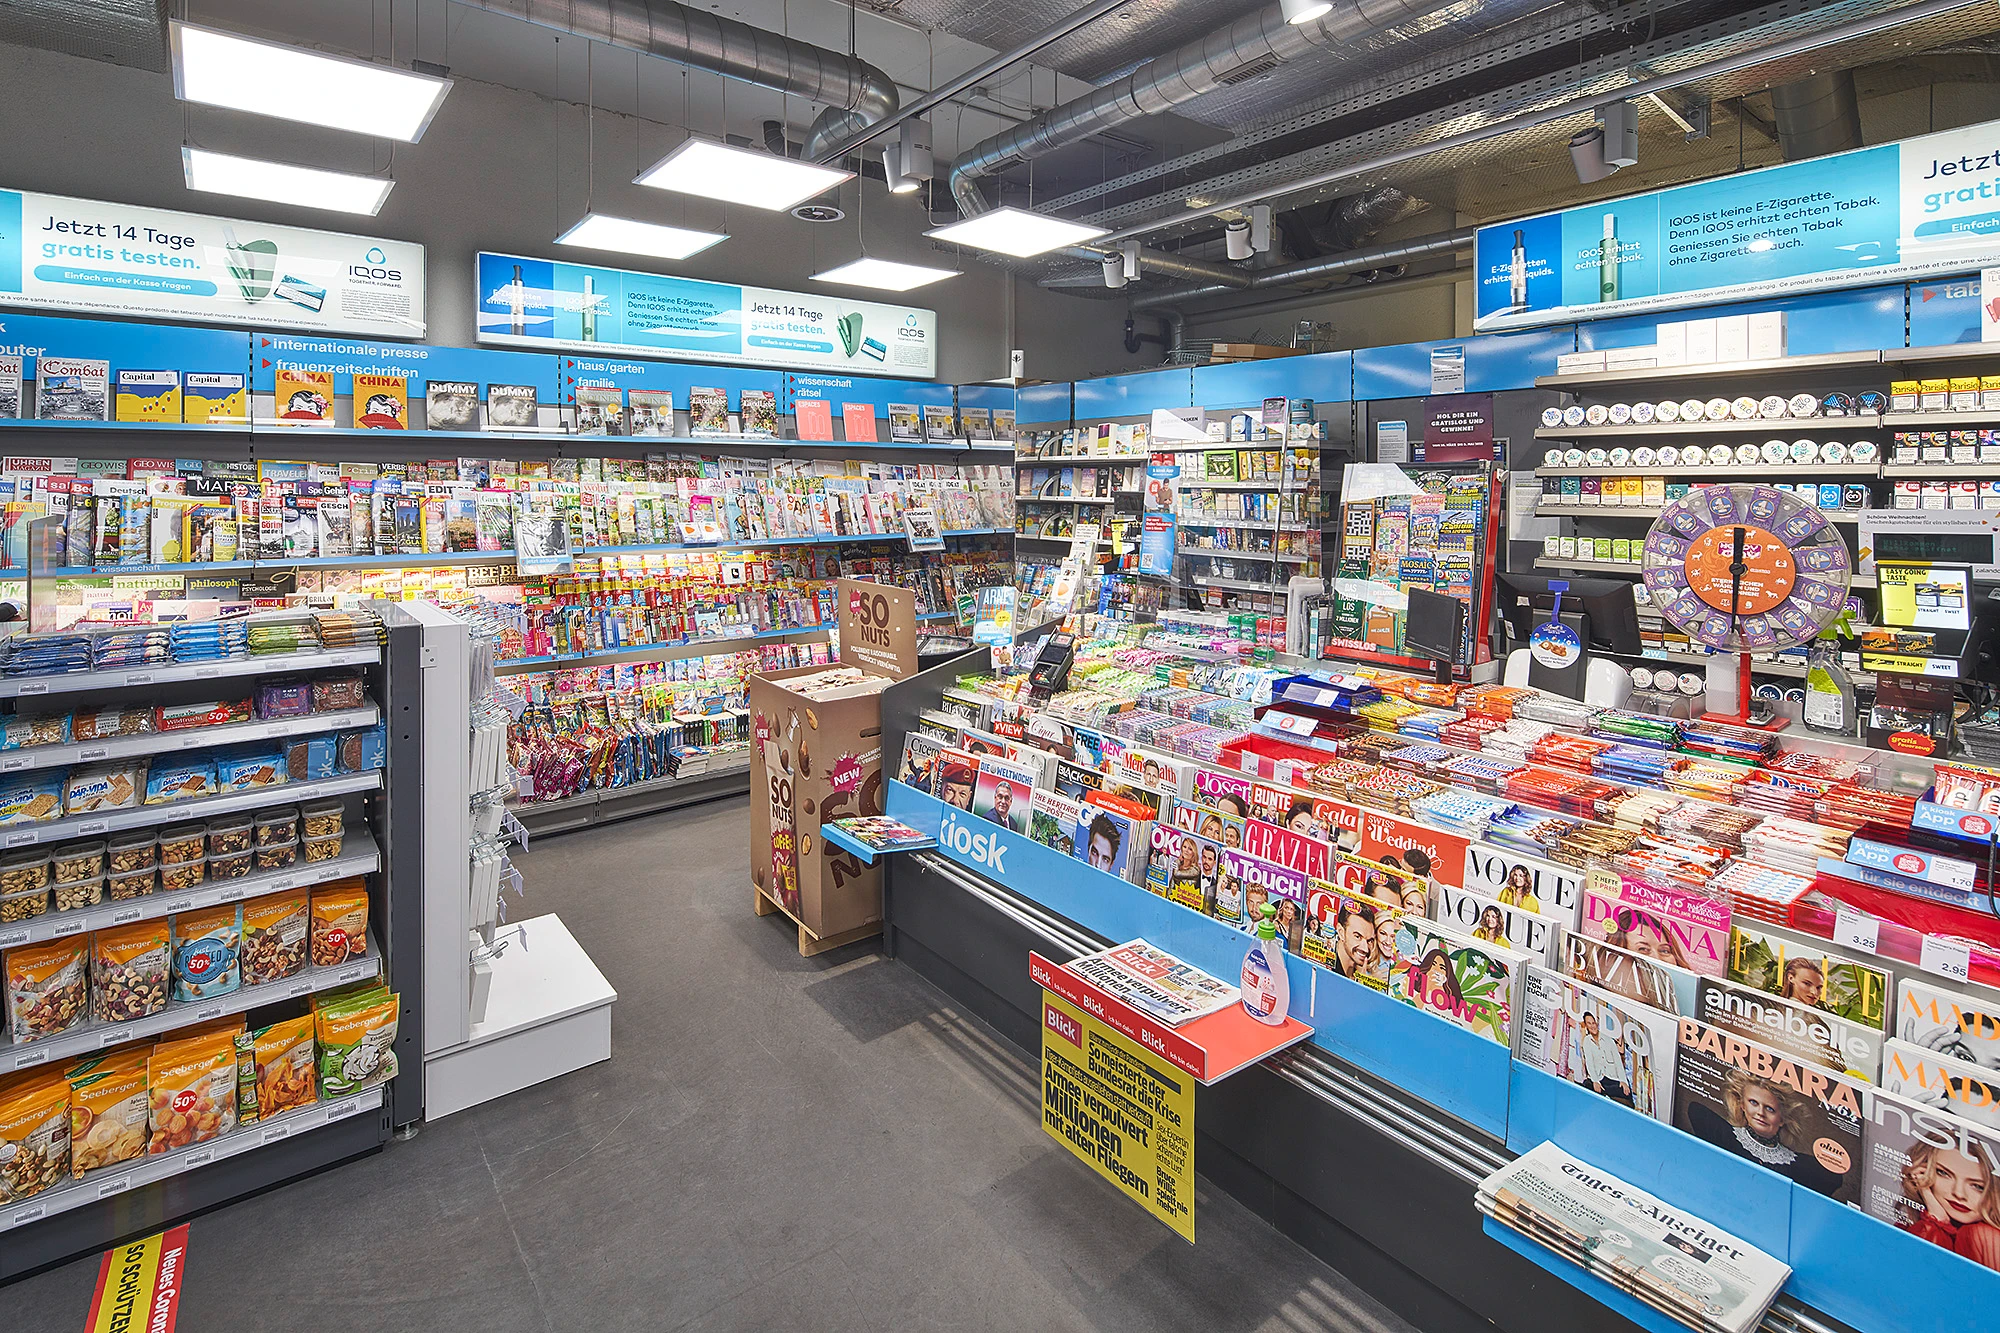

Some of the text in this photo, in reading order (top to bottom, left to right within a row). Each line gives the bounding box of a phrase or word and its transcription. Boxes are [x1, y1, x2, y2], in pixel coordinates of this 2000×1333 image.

[1669, 191, 1835, 228] IQOS ist keine E-Zigarette.
[1669, 195, 1880, 240] Denn IQOS erhitzt echten Tabak.
[42, 216, 196, 250] Jetzt 14 Tage
[1668, 216, 1843, 254] Geniessen Sie echten Tabak
[1951, 219, 1999, 233] Einfach
[42, 241, 201, 270] gratis testen.
[1578, 241, 1641, 260] IQOS erhitzt
[1574, 253, 1644, 271] echten Tabak.
[1668, 253, 1697, 267] ohne
[349, 265, 402, 281] IQOS
[1790, 270, 1880, 287] produit tabac peut nuire
[64, 270, 192, 295] Einfach an der Kasse fragen
[628, 292, 656, 302] IQOS ist
[628, 302, 665, 312] Denn IQOS
[750, 301, 781, 317] Jetzt
[783, 305, 796, 316] 14
[797, 307, 823, 322] Tage
[628, 320, 645, 328] ohne
[786, 322, 826, 335] testen.
[901, 327, 929, 338] IQOS
[273, 338, 429, 360] internationale presse
[43, 360, 105, 378] Combat
[276, 359, 419, 379] frauenzeitschriften
[577, 360, 645, 375] haus/garten
[121, 372, 155, 382] Capital
[189, 375, 221, 384] Capital
[282, 372, 327, 384] CHINA
[359, 375, 401, 388] CHINA
[577, 376, 615, 390] familie
[797, 377, 852, 388] wissenschaft
[429, 383, 477, 395] DUMMY
[797, 387, 822, 398] rätsel
[844, 404, 866, 412] ESPACES
[12, 458, 51, 467] UHREN
[80, 461, 104, 470] GEO
[133, 459, 155, 467] GEO
[99, 564, 161, 574] wissenschaft
[1885, 568, 1927, 576] EASY GOING
[116, 578, 182, 590] natürlich
[859, 591, 890, 629] SO
[861, 625, 891, 648] NUTS
[1331, 636, 1377, 652] SWISSLOS
[1896, 660, 1923, 668] STRAIGHT
[208, 711, 230, 721] 50%
[756, 728, 769, 740] NEW
[1890, 736, 1918, 749] gratis
[910, 736, 940, 759] Cicero
[833, 766, 861, 786] NEW
[980, 761, 1033, 786] DIE WELTWOCHE
[69, 782, 108, 799] DAR-VIDA
[1195, 769, 1250, 797] Closer
[769, 775, 792, 812] SO
[1255, 787, 1293, 812] BUNTE
[1034, 791, 1079, 816] THE HERITAGE
[1046, 805, 1064, 819] POST
[1928, 807, 1956, 817] kiosk
[771, 807, 793, 826] NUTS
[1315, 803, 1357, 829] Gala
[1367, 814, 1396, 831] SWISS
[1920, 812, 1956, 827] App
[1245, 821, 1330, 882] GRAZIA
[1370, 825, 1438, 861] Wedding
[1865, 843, 1891, 854] kiosk
[1854, 848, 1890, 863] App
[1599, 882, 1618, 894] PREIS
[1600, 876, 1618, 887] HEFTE
[1860, 869, 1980, 908] für sie entdeckt
[1951, 876, 1973, 888] 1.70
[247, 903, 292, 920] Seeberger
[318, 902, 355, 912] Seeberger
[185, 920, 222, 932] Seeberger
[1586, 894, 1721, 962] DONNA
[106, 939, 152, 954] Seeberger
[327, 933, 348, 943] 50%
[1851, 935, 1877, 949] 3.25
[19, 952, 72, 974] Seeberger
[188, 958, 211, 970] 50%
[1117, 949, 1158, 975] Blick
[1941, 961, 1968, 977] 2.95
[1076, 960, 1133, 995] Millionen
[1090, 957, 1129, 982] Armee
[1126, 977, 1193, 1015] verpulvert
[1408, 964, 1478, 1024] flow
[1031, 964, 1052, 987] Blick
[1083, 993, 1105, 1018] Blick
[1141, 1028, 1166, 1055] Blick
[331, 1014, 380, 1035] Seeberger
[1047, 1008, 1076, 1041] Blick
[1704, 985, 1871, 1059] annabelle
[160, 1056, 215, 1080] Seeberger
[1088, 1041, 1101, 1058] So
[1102, 1049, 1150, 1086] meisterte
[1150, 1077, 1166, 1101] der
[1678, 1019, 1863, 1119] BARBARA
[80, 1079, 138, 1103] Seeberger
[1088, 1056, 1137, 1098] Bundesrat
[1137, 1088, 1154, 1109] die
[1154, 1097, 1182, 1129] Krise
[173, 1094, 197, 1109] 50%
[1045, 1062, 1082, 1103] Armee
[1082, 1084, 1149, 1150] verpulvert
[0, 1105, 54, 1133] Seeberger
[1045, 1081, 1123, 1160] Millionen
[1045, 1107, 1150, 1200] mit alten Fliegern
[1874, 1142, 1912, 1162] AMANDA
[1156, 1165, 1177, 1187] Bruce
[1156, 1188, 1189, 1217] spielt nie
[1156, 1196, 1178, 1219] mehr!
[125, 1243, 146, 1263] SO
[154, 1246, 179, 1290] Neues
